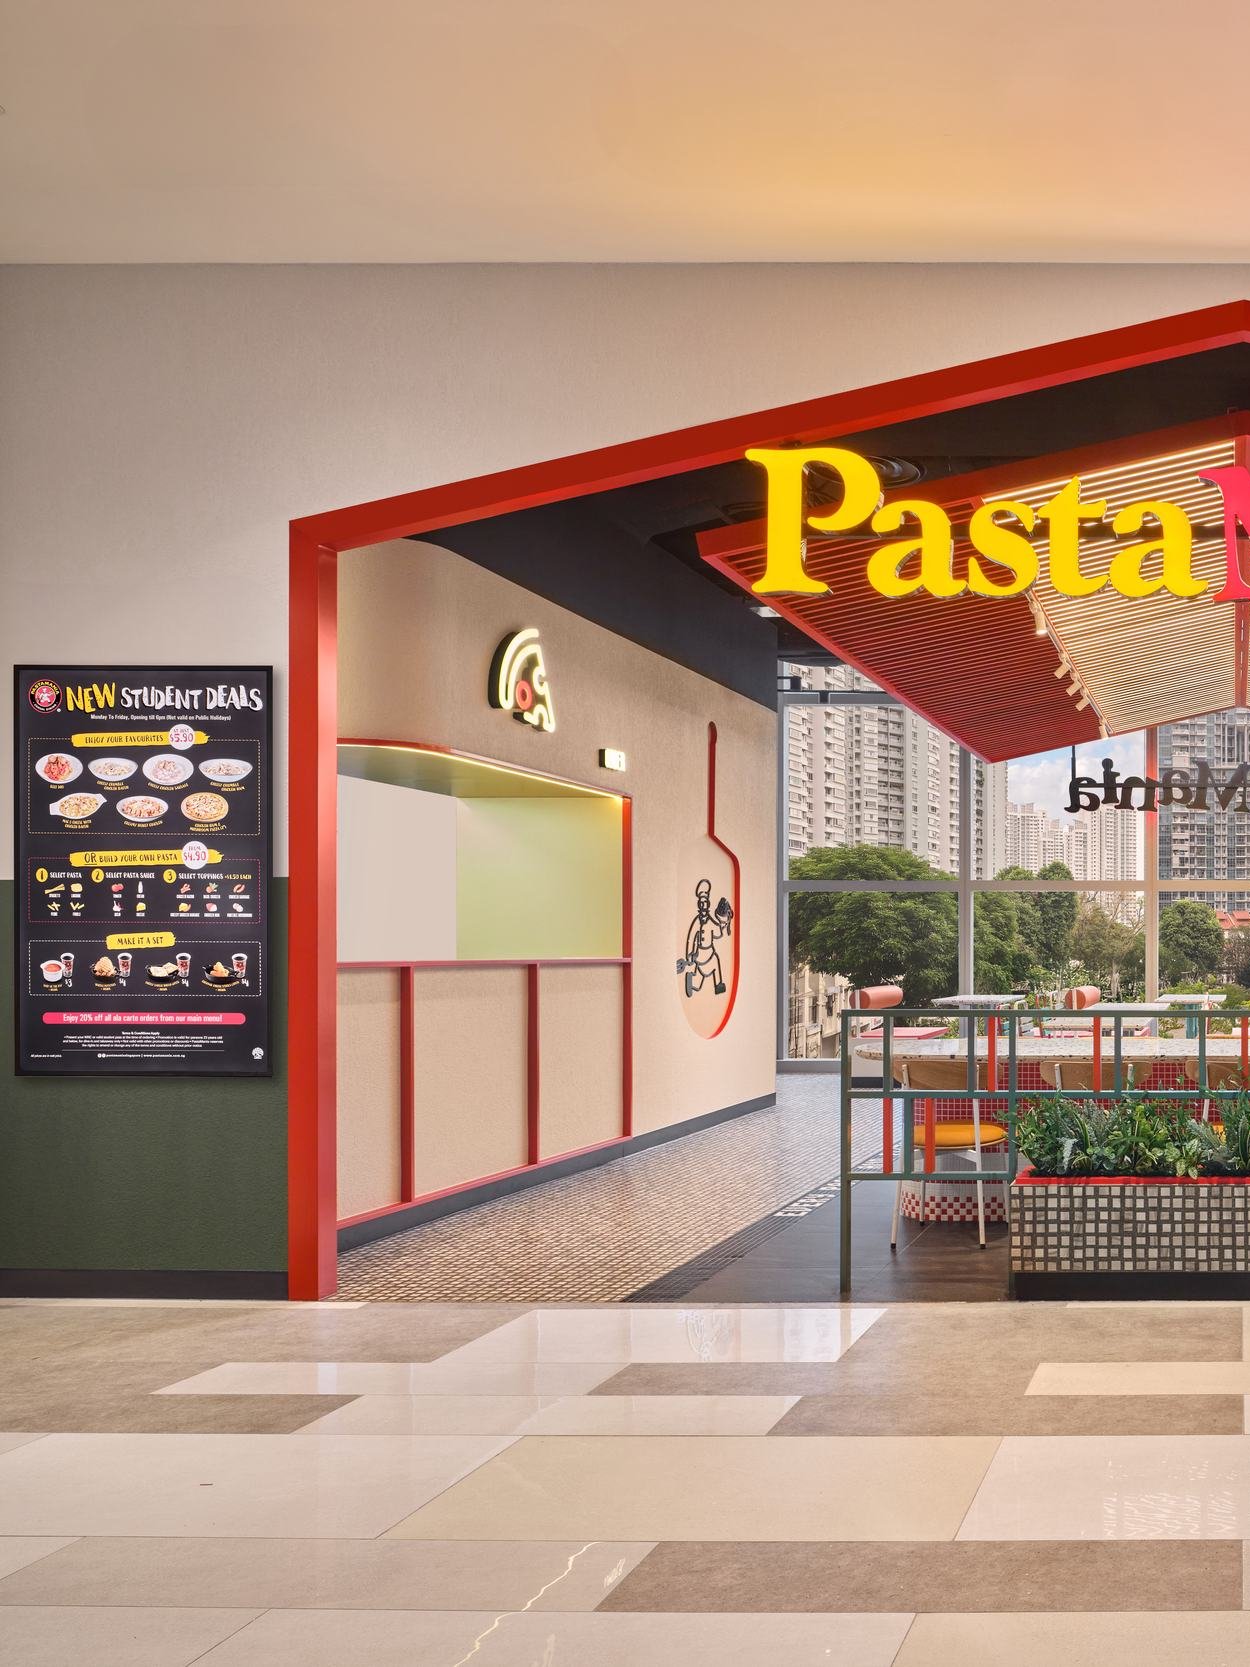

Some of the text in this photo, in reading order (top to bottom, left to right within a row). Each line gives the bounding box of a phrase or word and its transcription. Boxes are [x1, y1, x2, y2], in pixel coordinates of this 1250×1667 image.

[66, 682, 263, 713] NEW STUDENT DEALS
[170, 733, 194, 743] $5.90
[84, 853, 97, 863] OR
[184, 852, 206, 861] $4.90
[96, 871, 100, 880] 2
[168, 871, 172, 881] 3
[65, 978, 72, 987] $3
[63, 1013, 78, 1023] Enjoy
